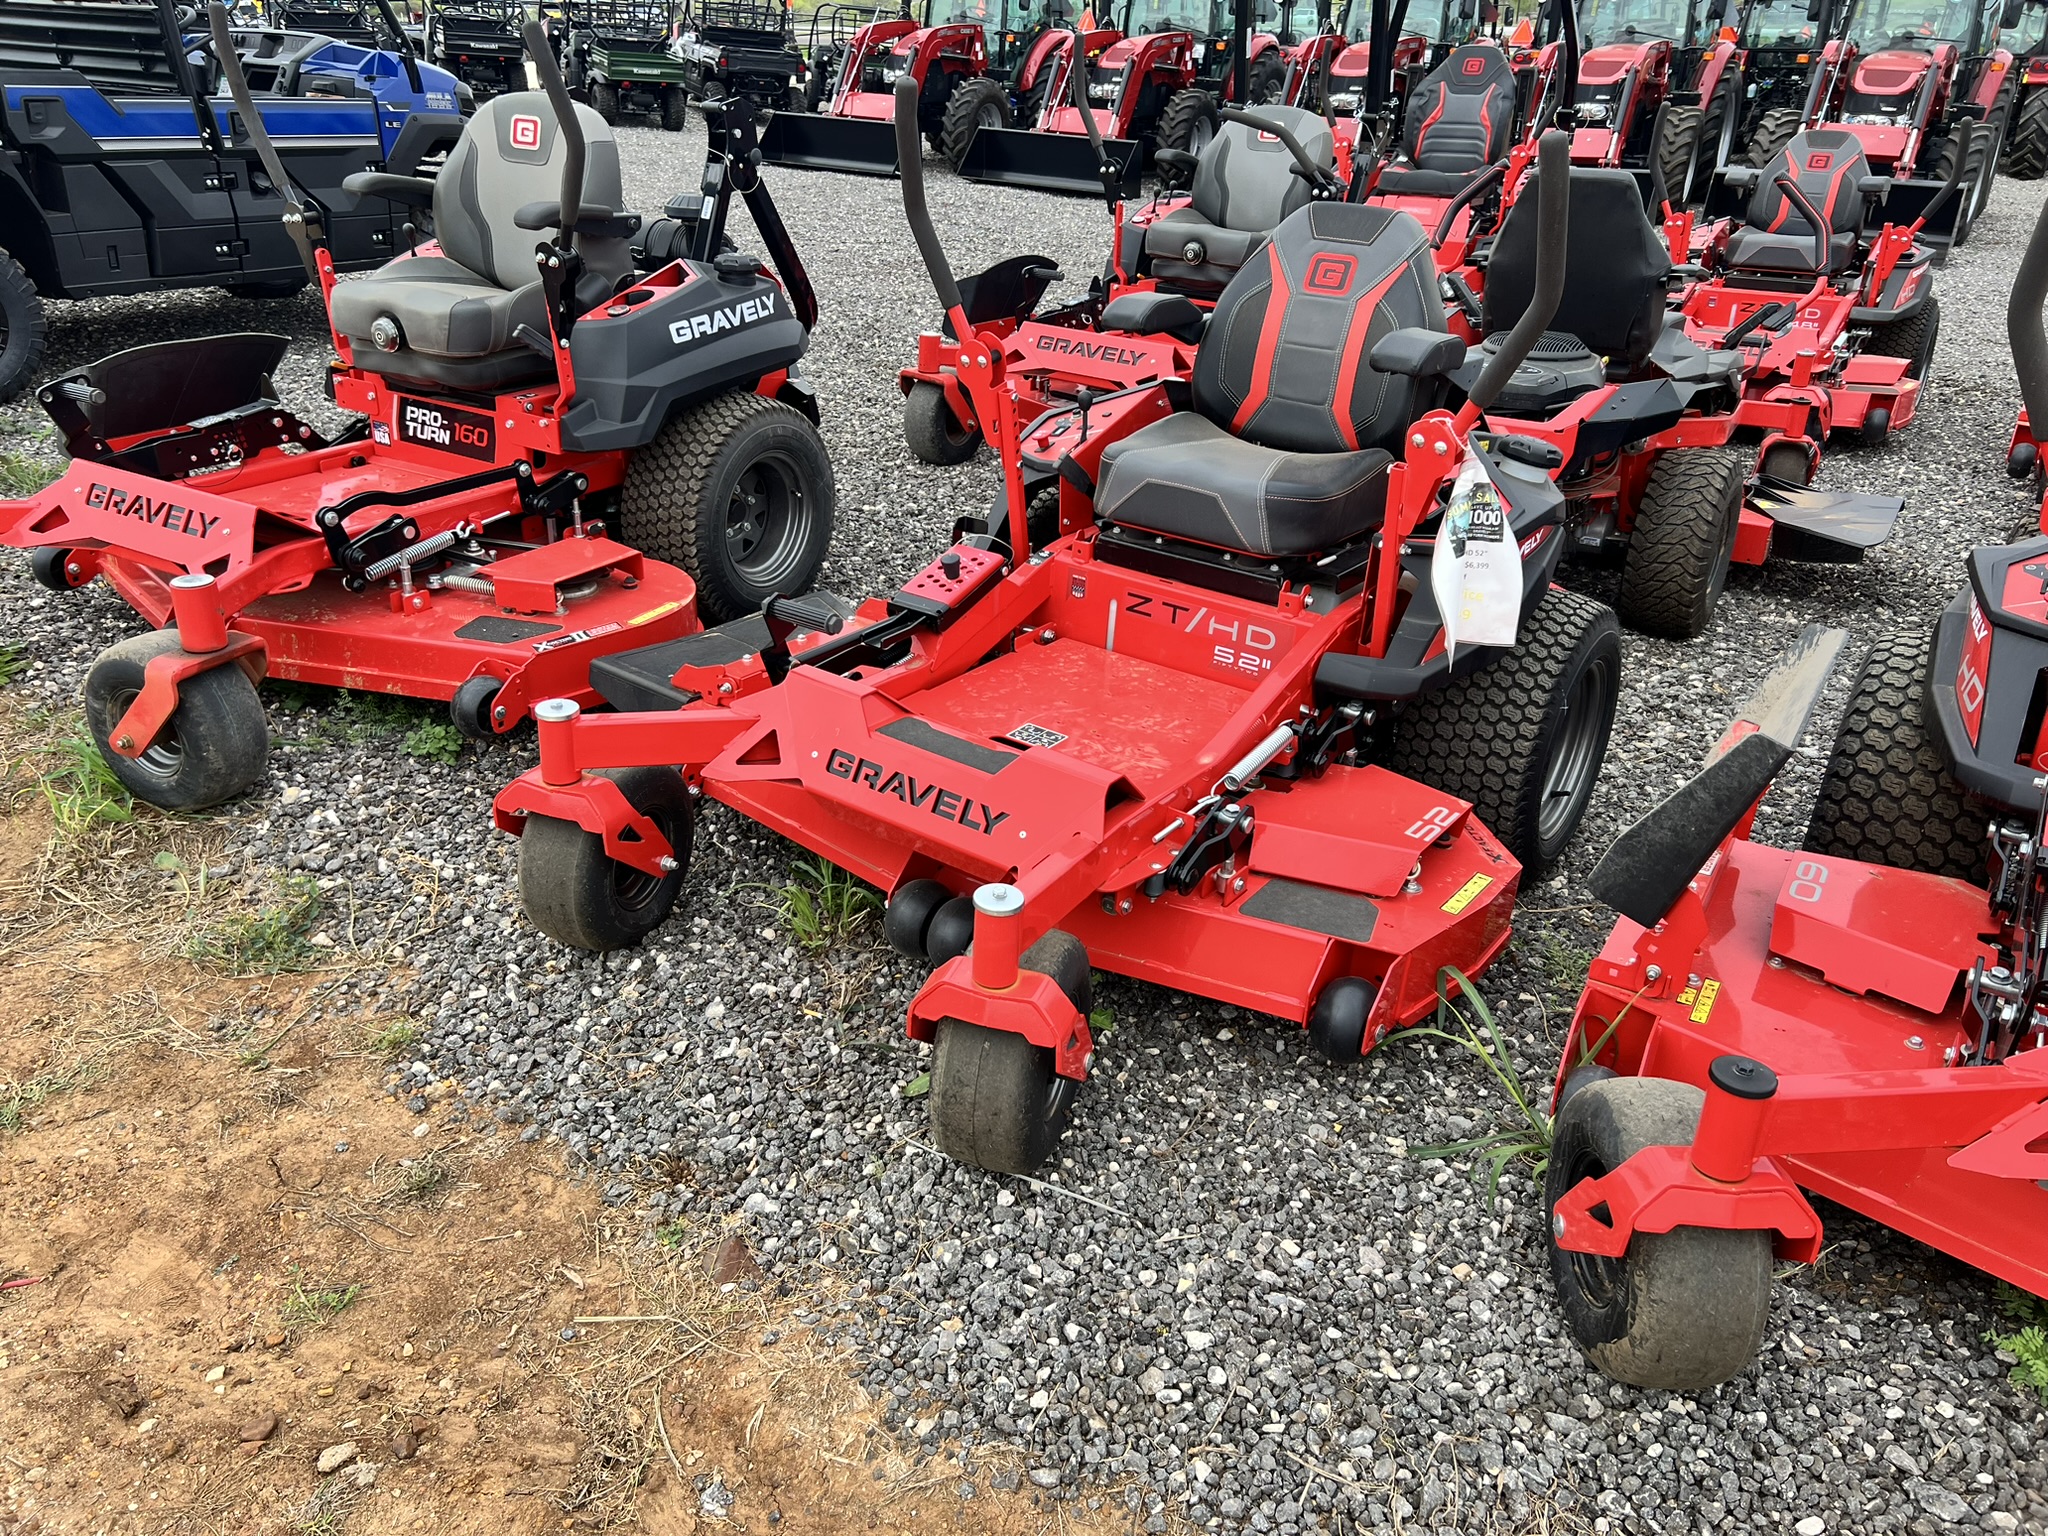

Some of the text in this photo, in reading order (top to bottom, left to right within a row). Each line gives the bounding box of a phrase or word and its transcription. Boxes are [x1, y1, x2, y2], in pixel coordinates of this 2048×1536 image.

[669, 293, 775, 344] GRAVELY
[1036, 335, 1147, 366] GRAVELY
[406, 406, 448, 427] PRO-
[406, 421, 488, 447] TURN 160
[374, 430, 391, 446] USA
[85, 482, 221, 539] GRAVELY
[1959, 654, 1984, 713] HD
[826, 748, 1010, 836] GRAVELY
[1404, 806, 1461, 842] 52
[1789, 861, 1829, 903] 60
